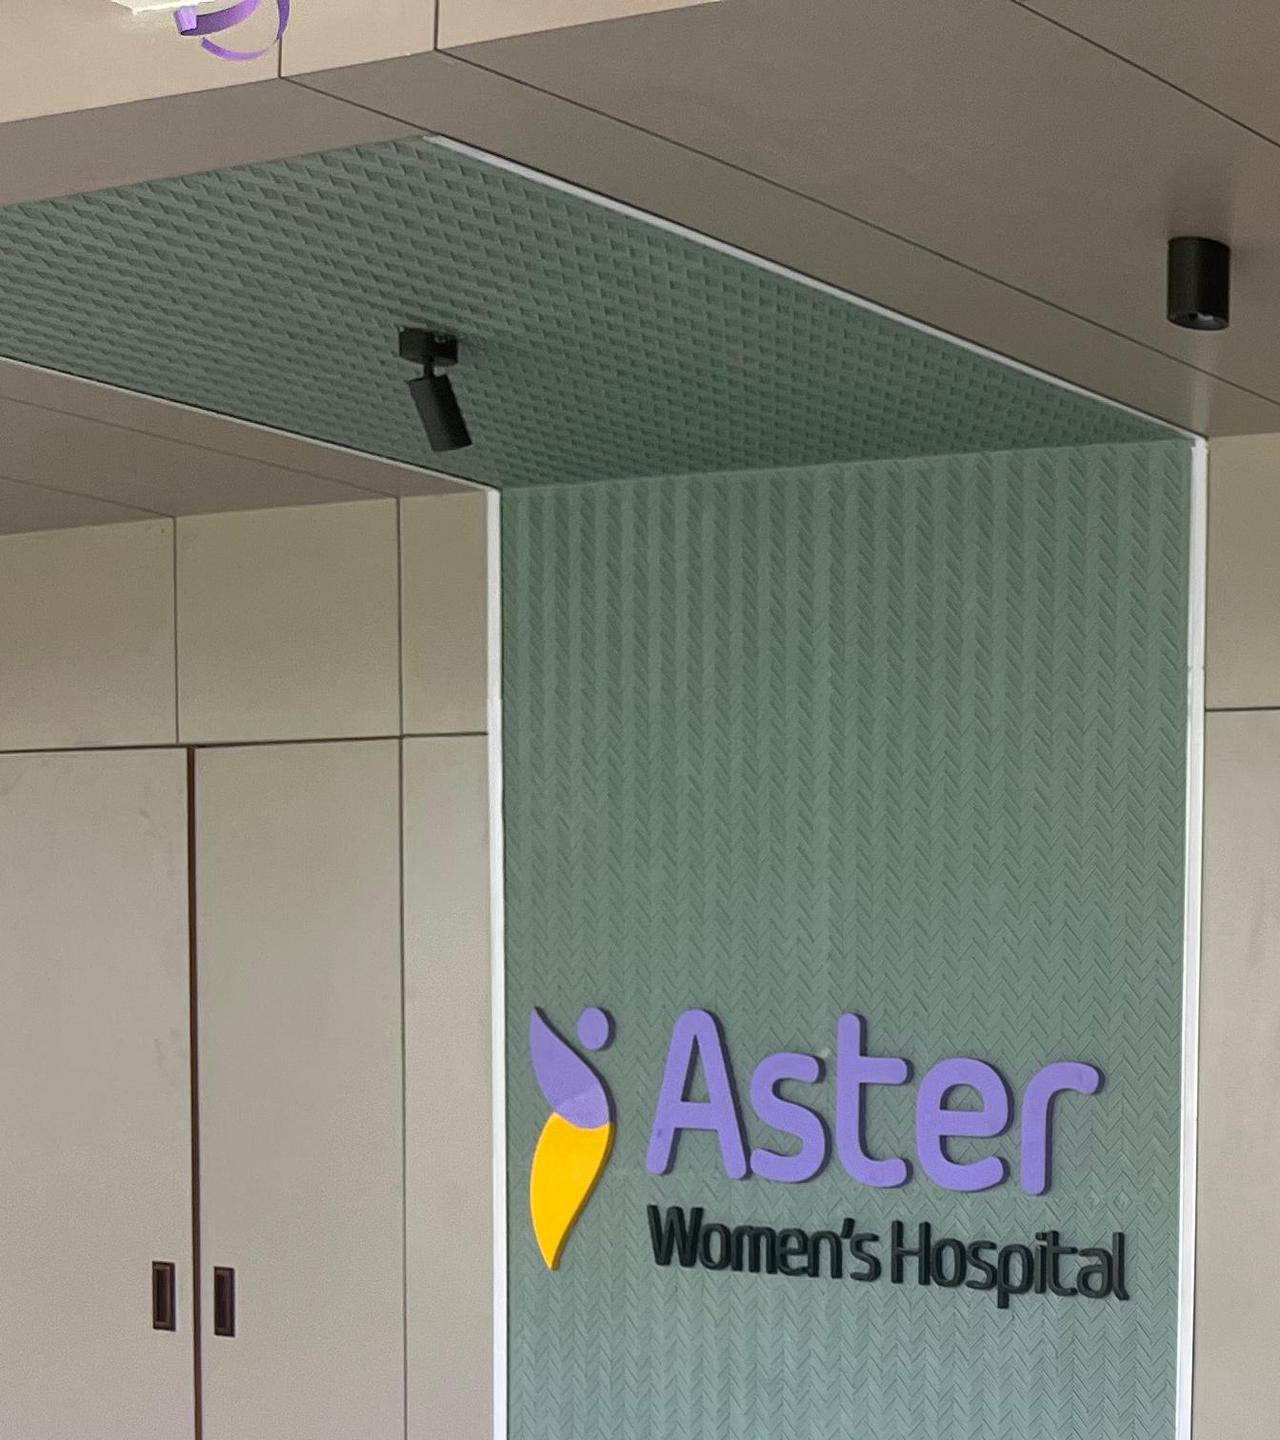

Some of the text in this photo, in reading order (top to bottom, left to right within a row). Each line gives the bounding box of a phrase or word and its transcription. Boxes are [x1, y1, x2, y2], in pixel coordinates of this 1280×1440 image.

[646, 1008, 1103, 1195] Aster
[647, 1204, 1130, 1309] Women's Hospital
